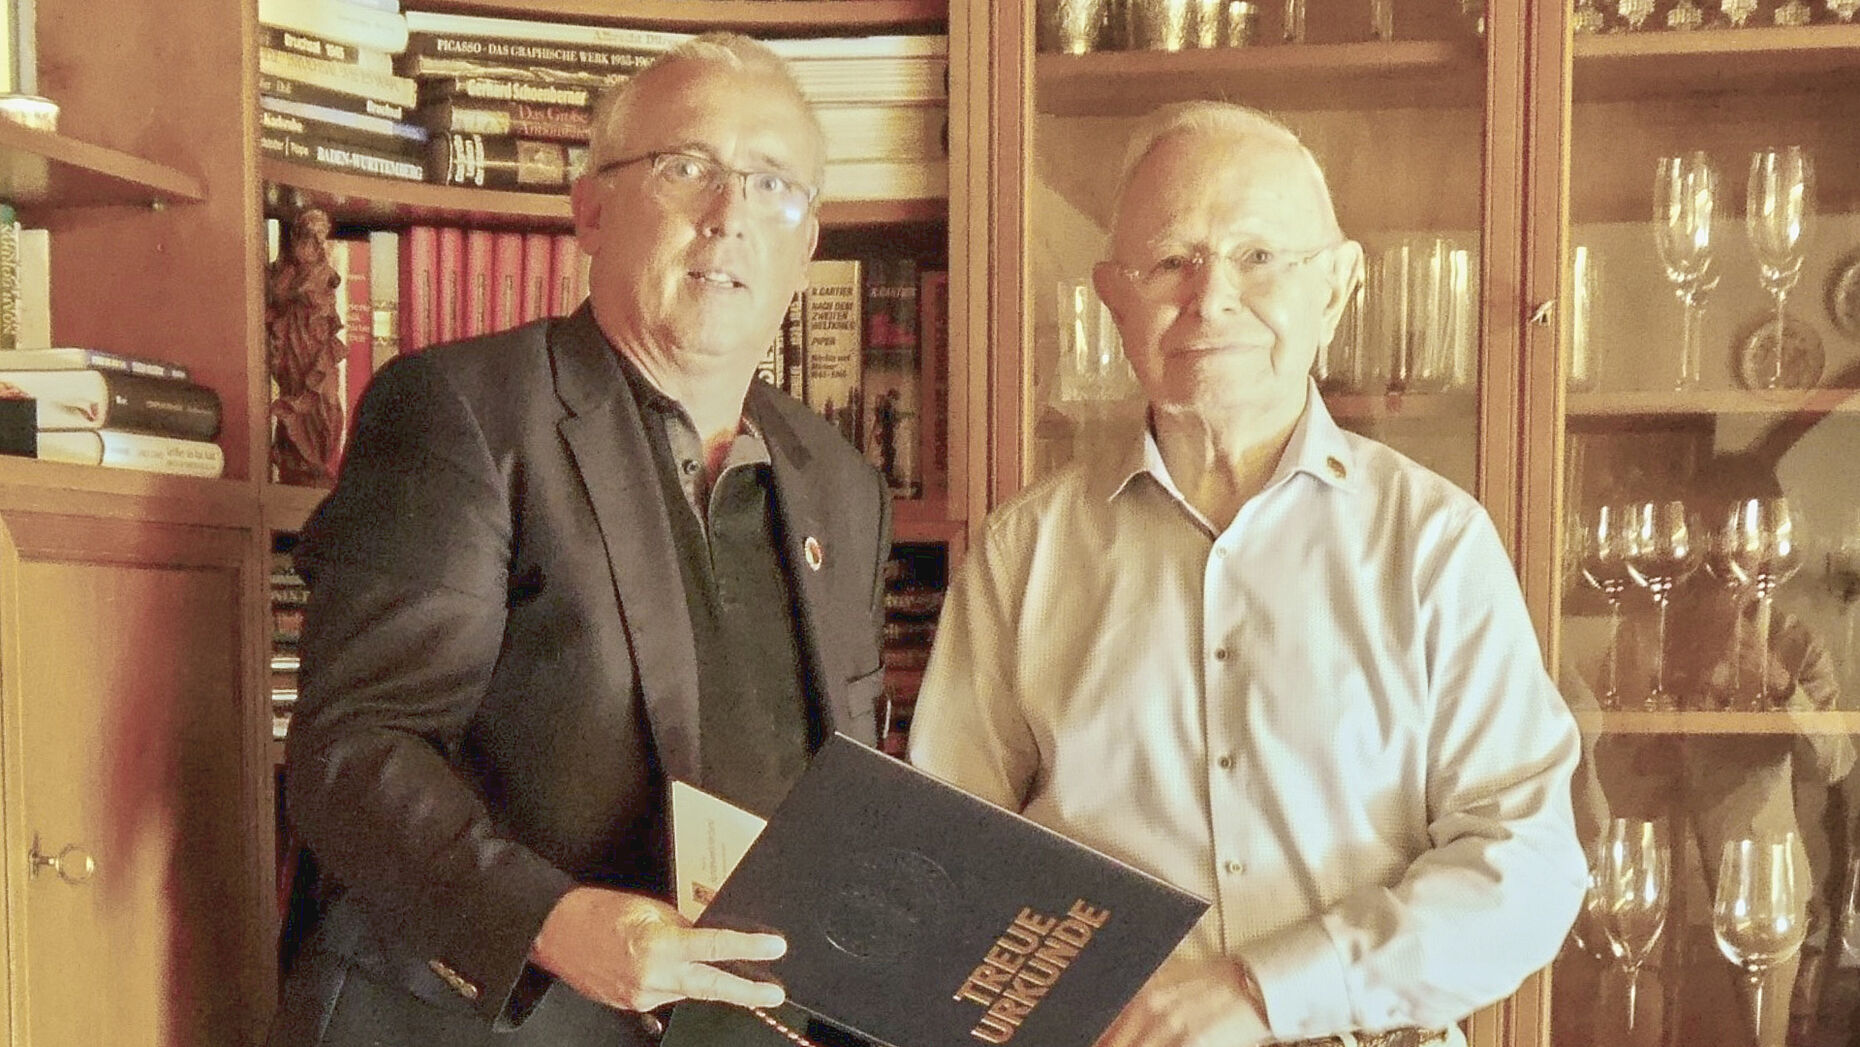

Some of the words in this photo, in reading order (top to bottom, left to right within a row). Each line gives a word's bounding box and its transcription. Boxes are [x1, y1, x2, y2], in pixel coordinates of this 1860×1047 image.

[437, 39, 482, 53] PICASSO
[488, 43, 509, 56] DAS
[511, 46, 578, 61] GRAPHISCHE
[579, 51, 609, 64] WERK
[819, 286, 854, 297] CARTIER
[811, 301, 833, 311] NACH
[835, 301, 854, 311] DEM
[812, 311, 848, 321] ZWEITEN
[811, 336, 836, 346] PIPER
[953, 906, 1057, 1006] TREUE
[970, 898, 1111, 1044] URKUNDE
